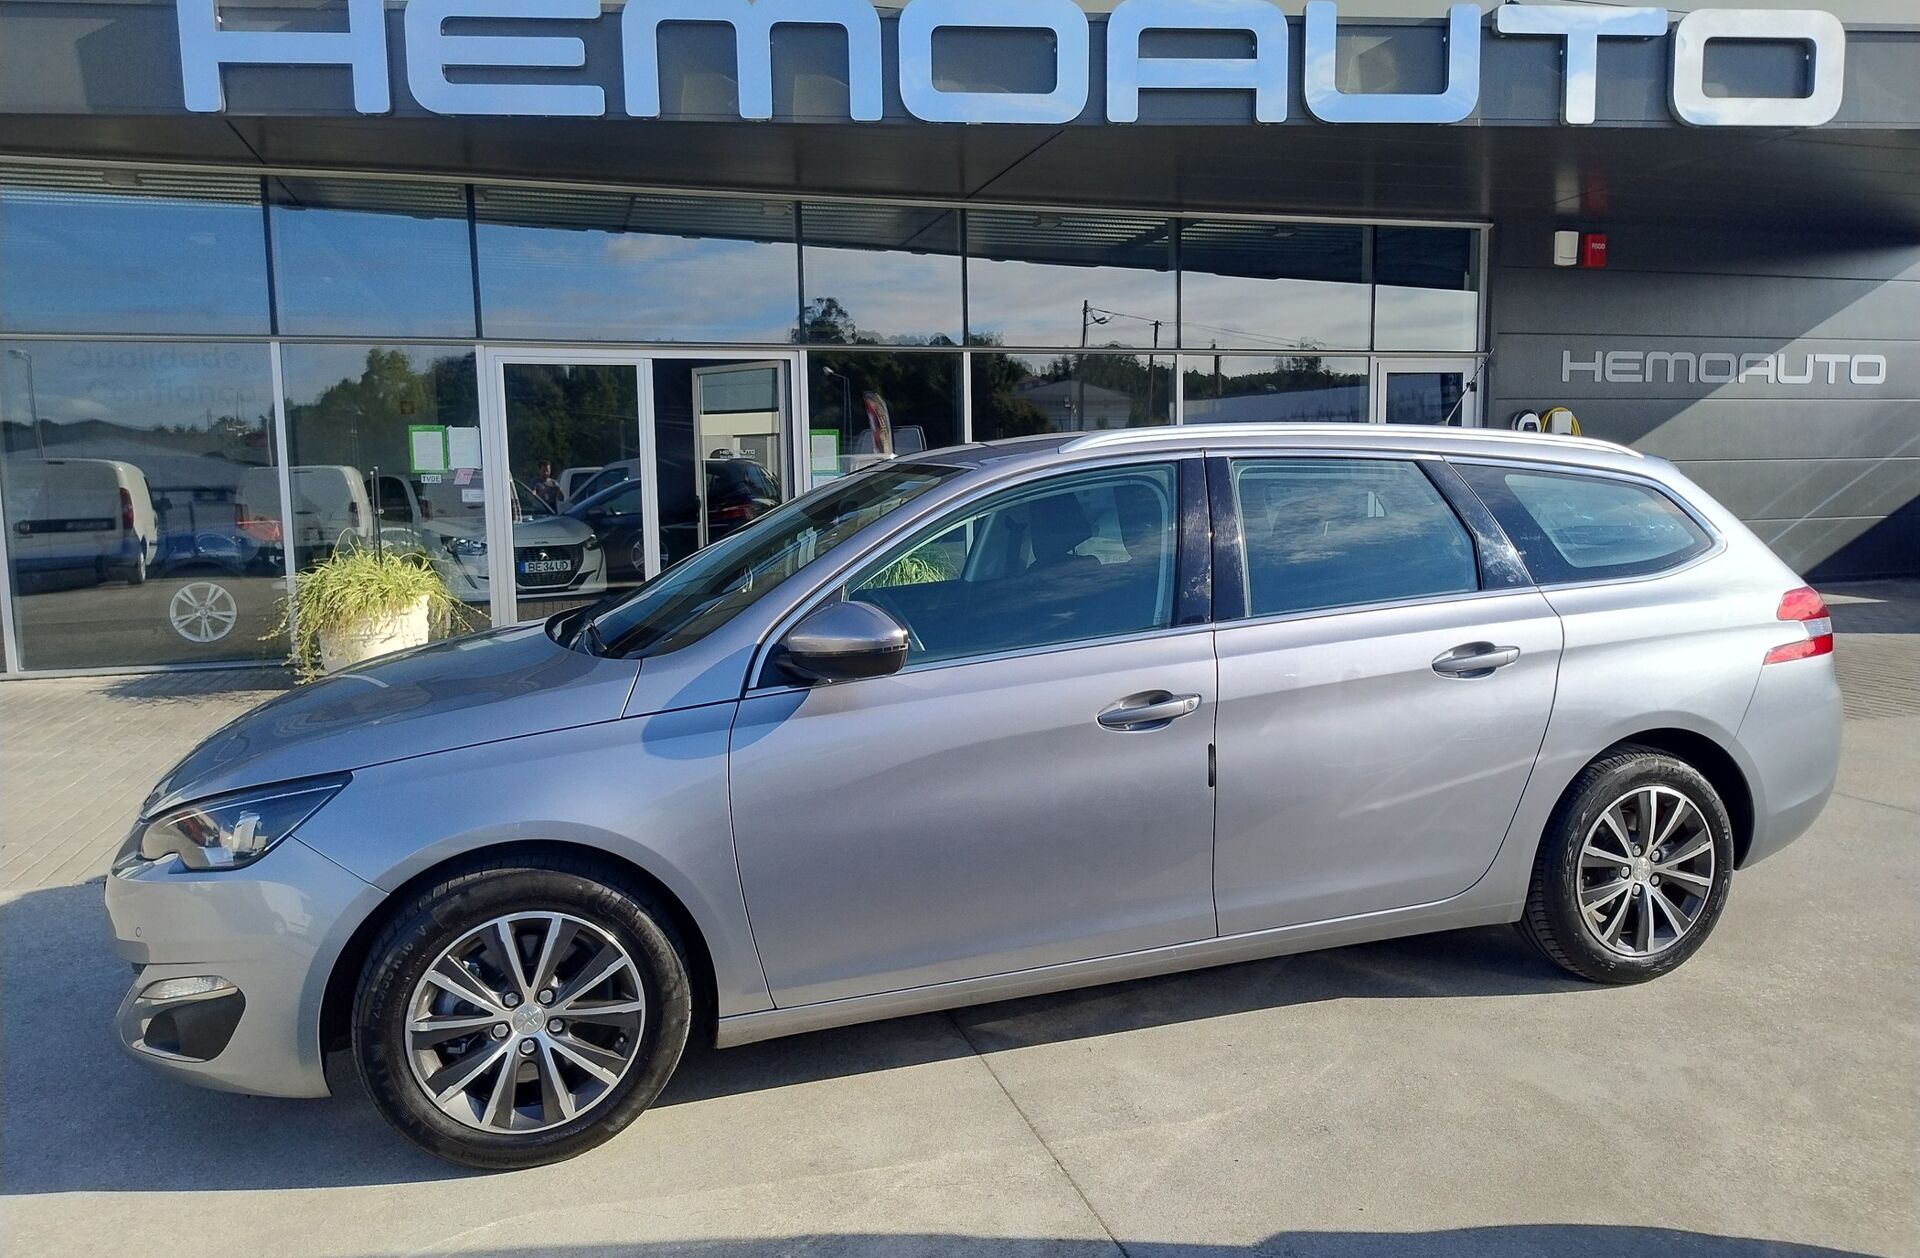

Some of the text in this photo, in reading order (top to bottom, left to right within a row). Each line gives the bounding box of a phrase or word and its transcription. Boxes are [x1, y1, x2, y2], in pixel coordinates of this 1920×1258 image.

[180, 0, 1846, 127] HEMOAUTO
[1562, 350, 1887, 385] HEMOAUTO
[421, 475, 441, 483] TVDE
